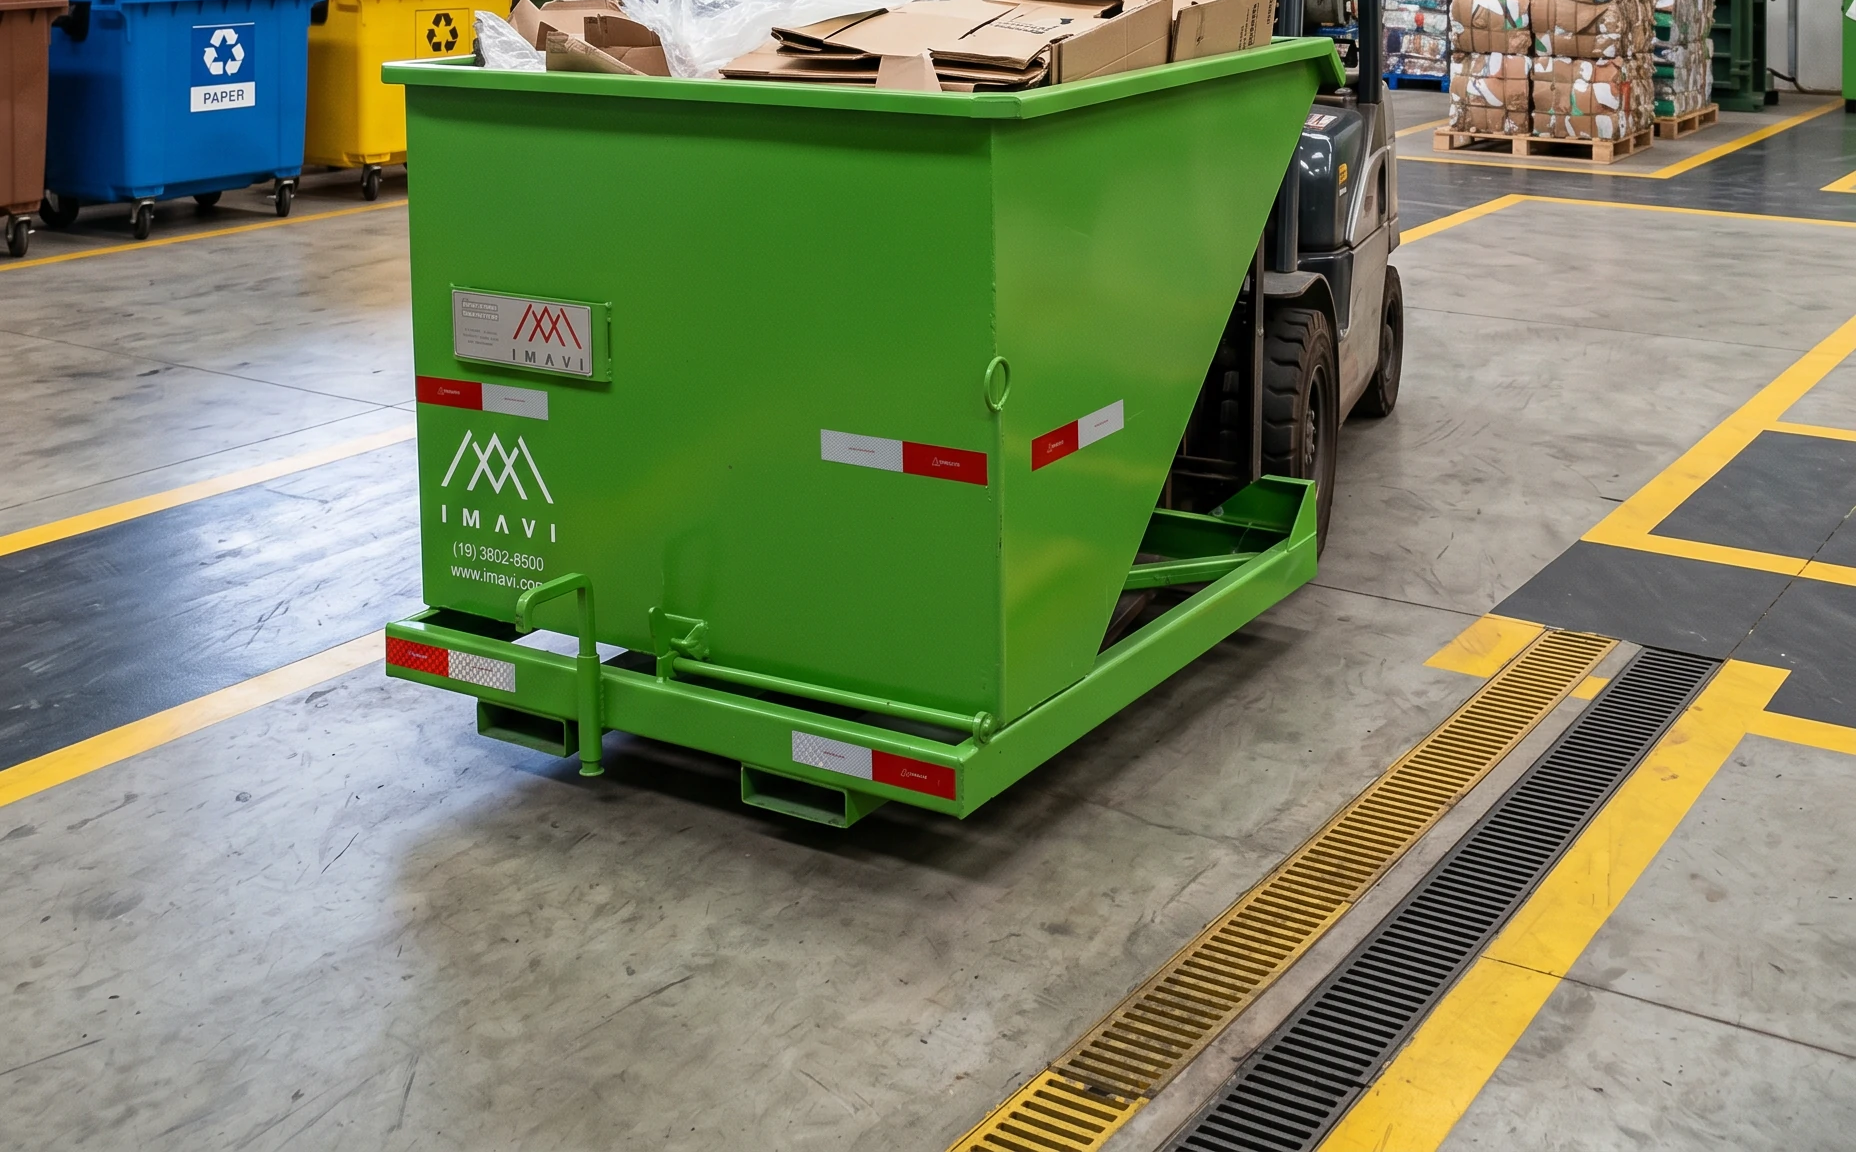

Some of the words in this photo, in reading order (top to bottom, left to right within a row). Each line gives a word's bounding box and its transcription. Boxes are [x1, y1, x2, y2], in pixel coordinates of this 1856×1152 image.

[203, 89, 245, 105] PAPER
[512, 348, 584, 371] IMAVI
[441, 504, 556, 543] IMAVI
[453, 541, 477, 562] (19)
[479, 546, 544, 572] 3802-8500
